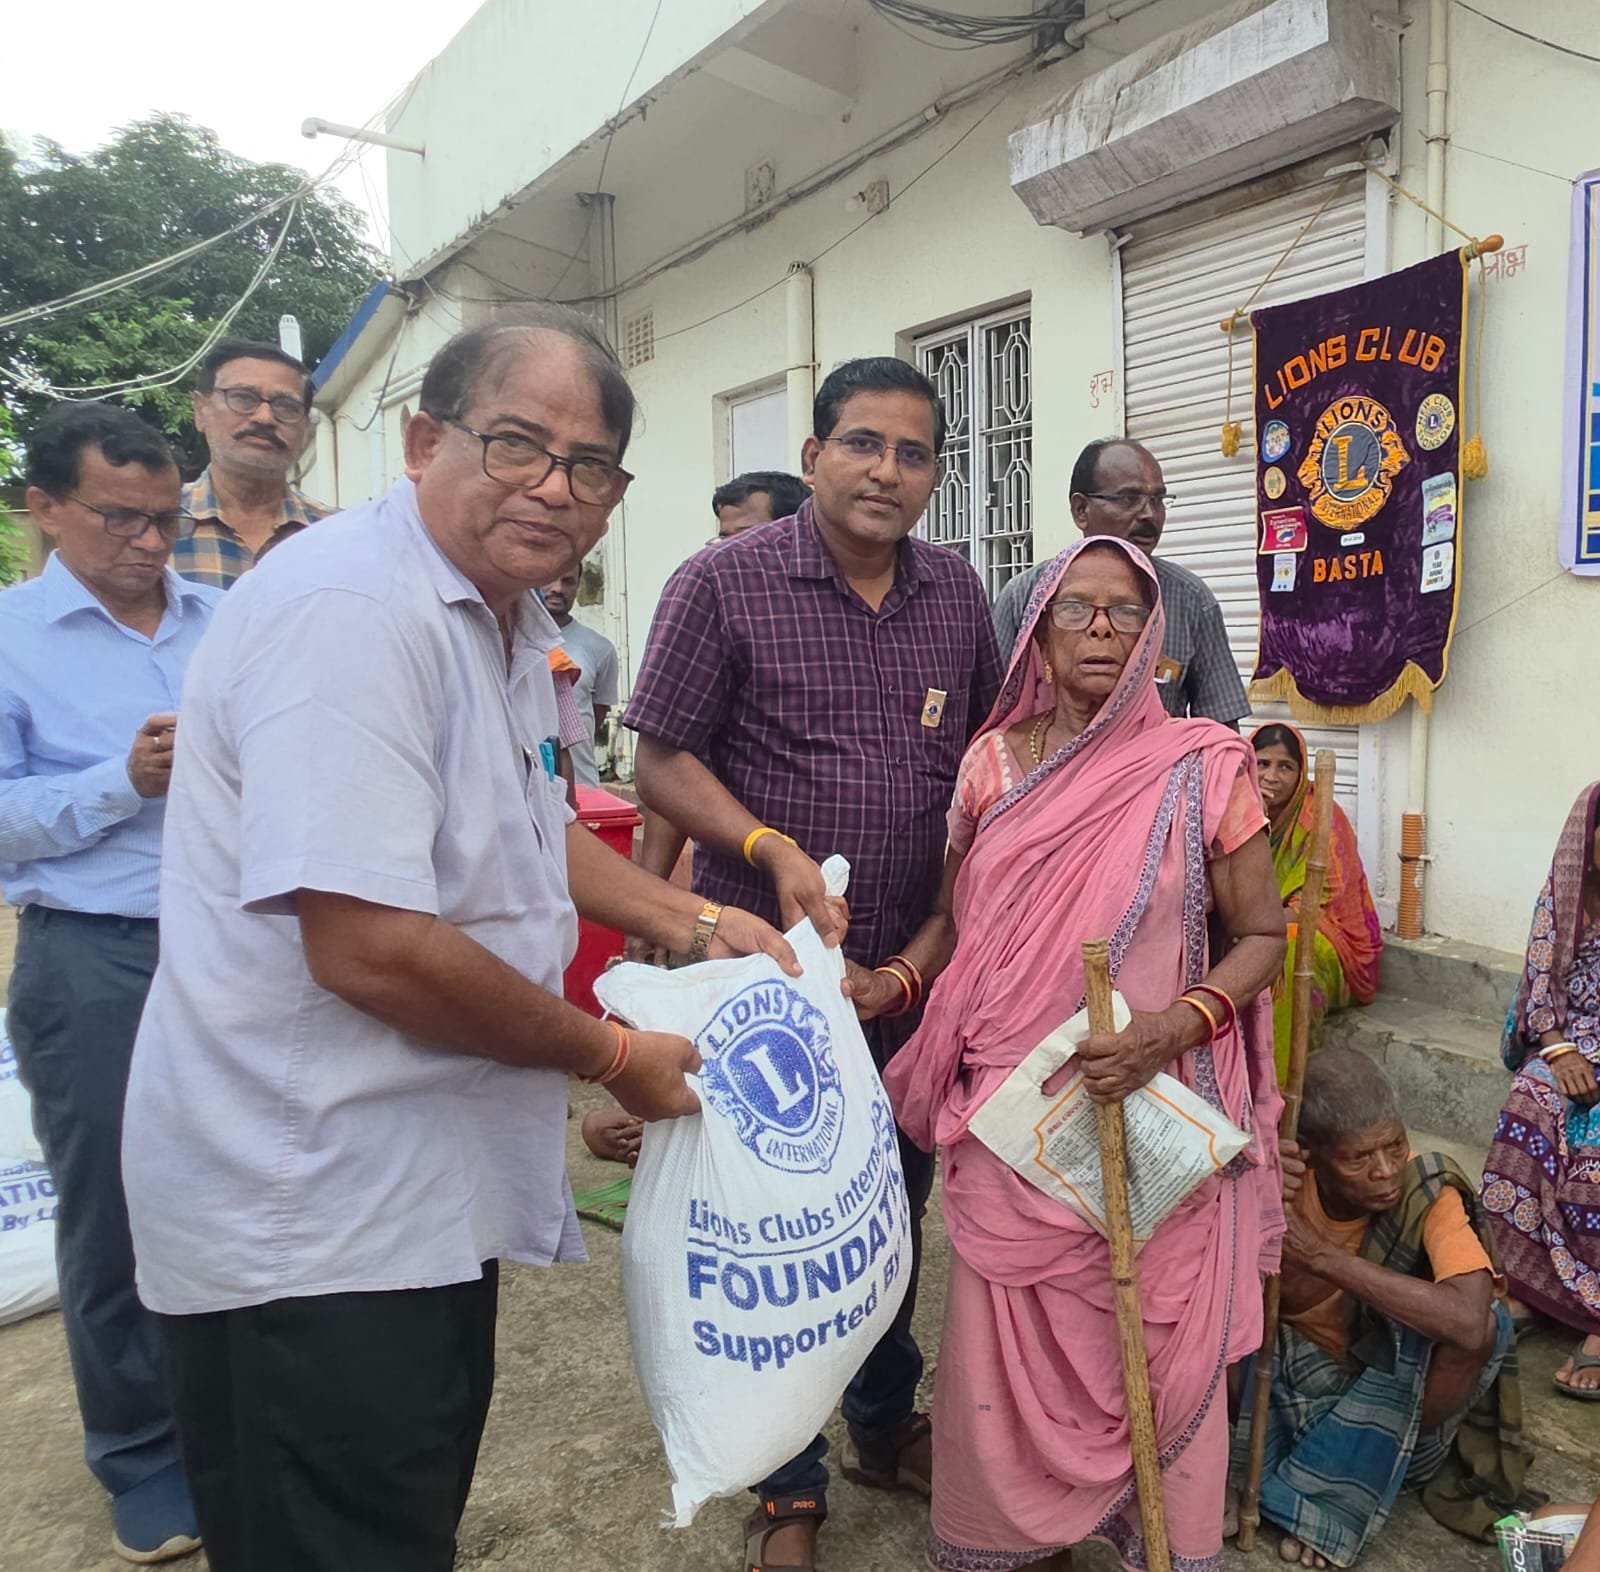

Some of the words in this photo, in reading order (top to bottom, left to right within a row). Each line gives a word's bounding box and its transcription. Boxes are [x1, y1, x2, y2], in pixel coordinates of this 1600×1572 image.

[1264, 334, 1347, 411] LIONS
[1355, 326, 1446, 372] CLUB
[1321, 400, 1384, 434] LIONS
[1332, 435, 1369, 492] L
[1313, 550, 1384, 583] BASTA
[706, 987, 784, 1054] LIONS
[742, 1043, 810, 1115] L
[765, 1099, 840, 1165] INTERNATIONAL
[689, 1199, 752, 1246] Lions
[758, 1207, 835, 1244] Clubs
[692, 1280, 877, 1371] Supported
[792, 1500, 816, 1509] PRO
